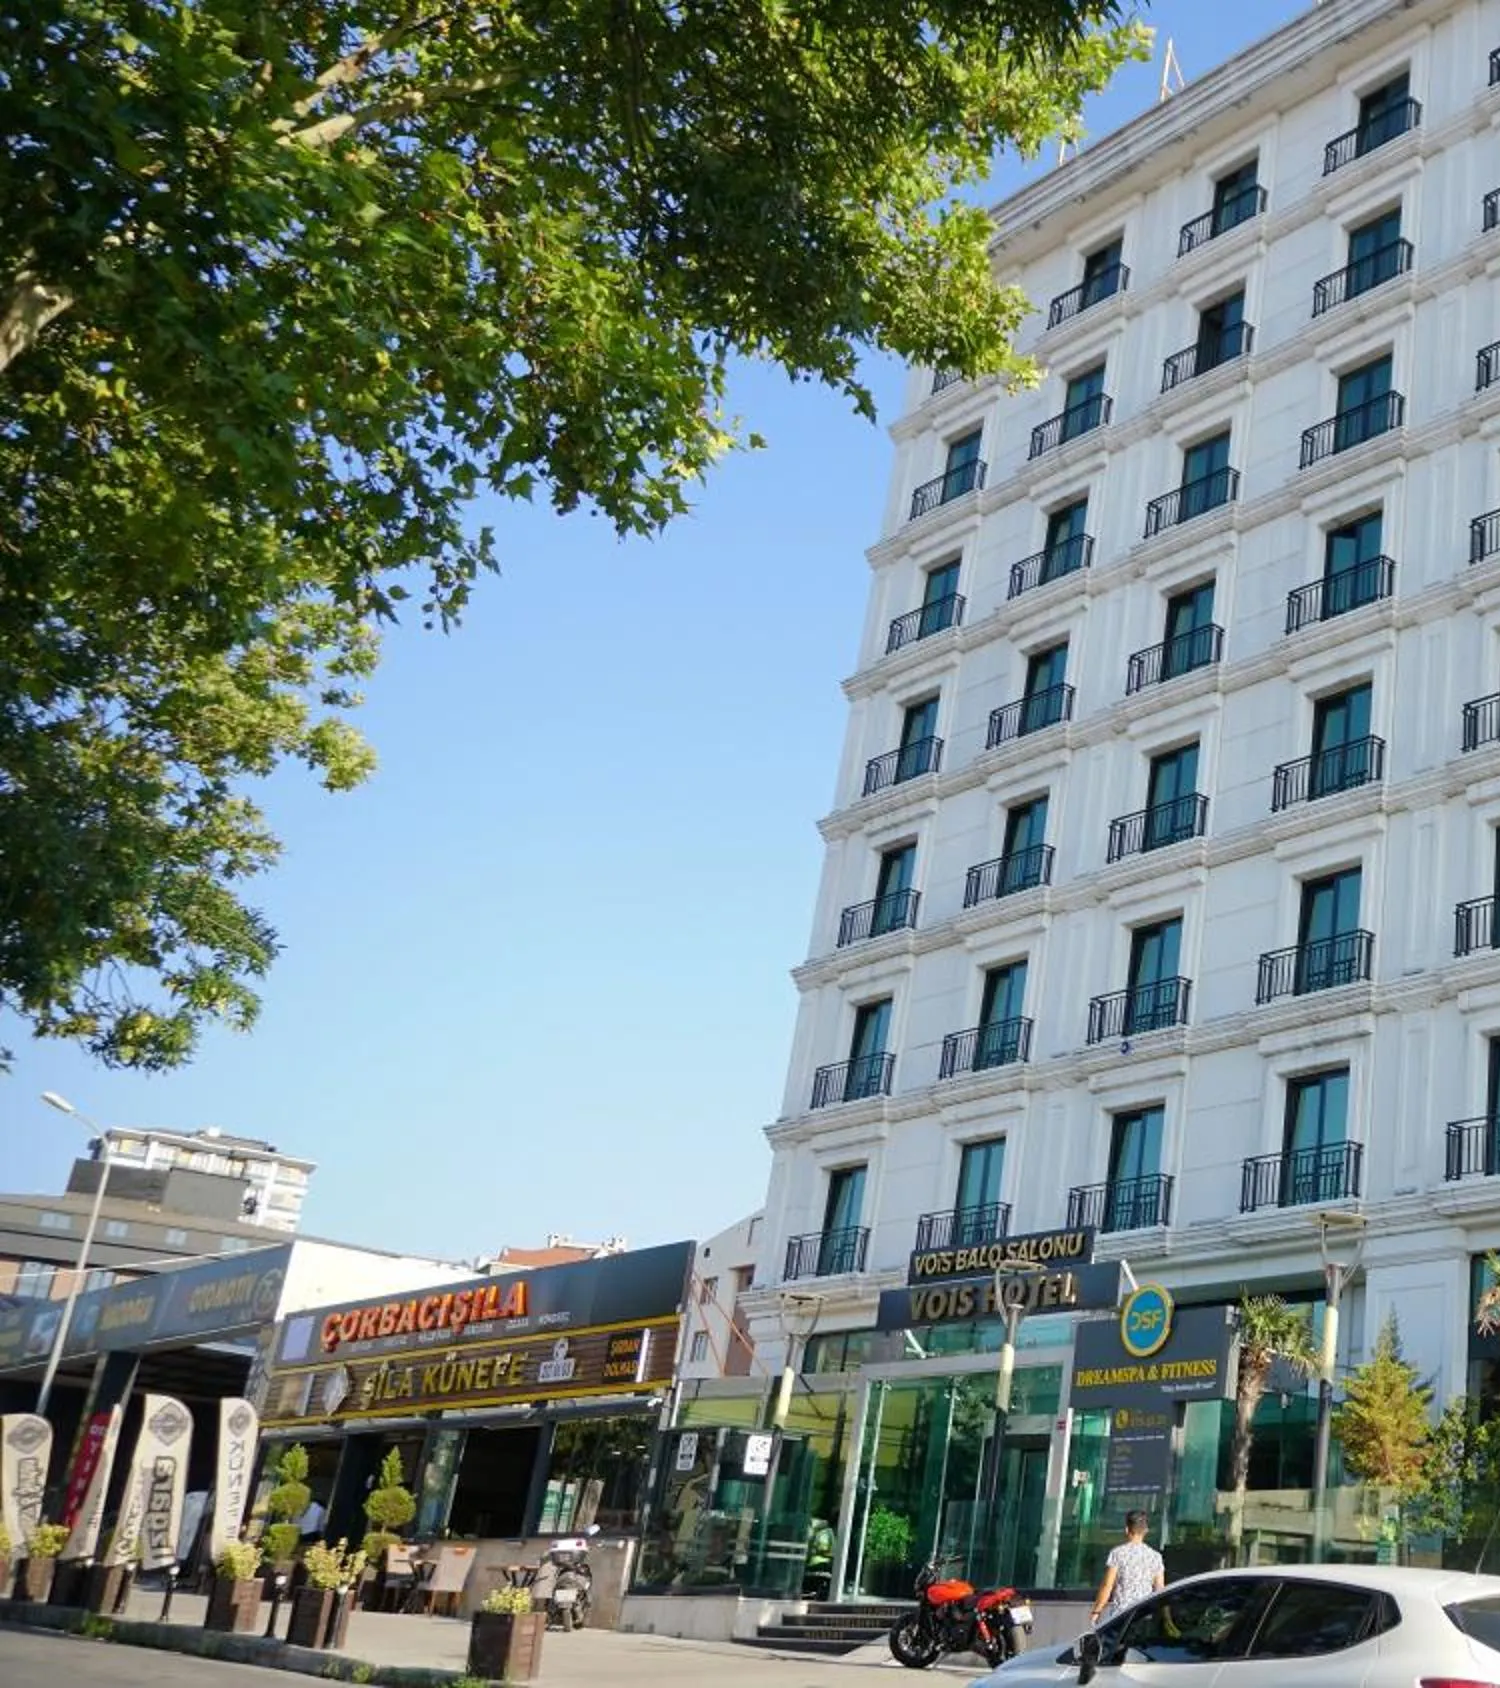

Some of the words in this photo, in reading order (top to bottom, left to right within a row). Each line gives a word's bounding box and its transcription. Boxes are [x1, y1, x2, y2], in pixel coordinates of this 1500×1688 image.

[955, 1245, 1001, 1271] BALO
[1006, 1232, 1083, 1262] SALONU
[983, 1272, 1077, 1312] HOTEL
